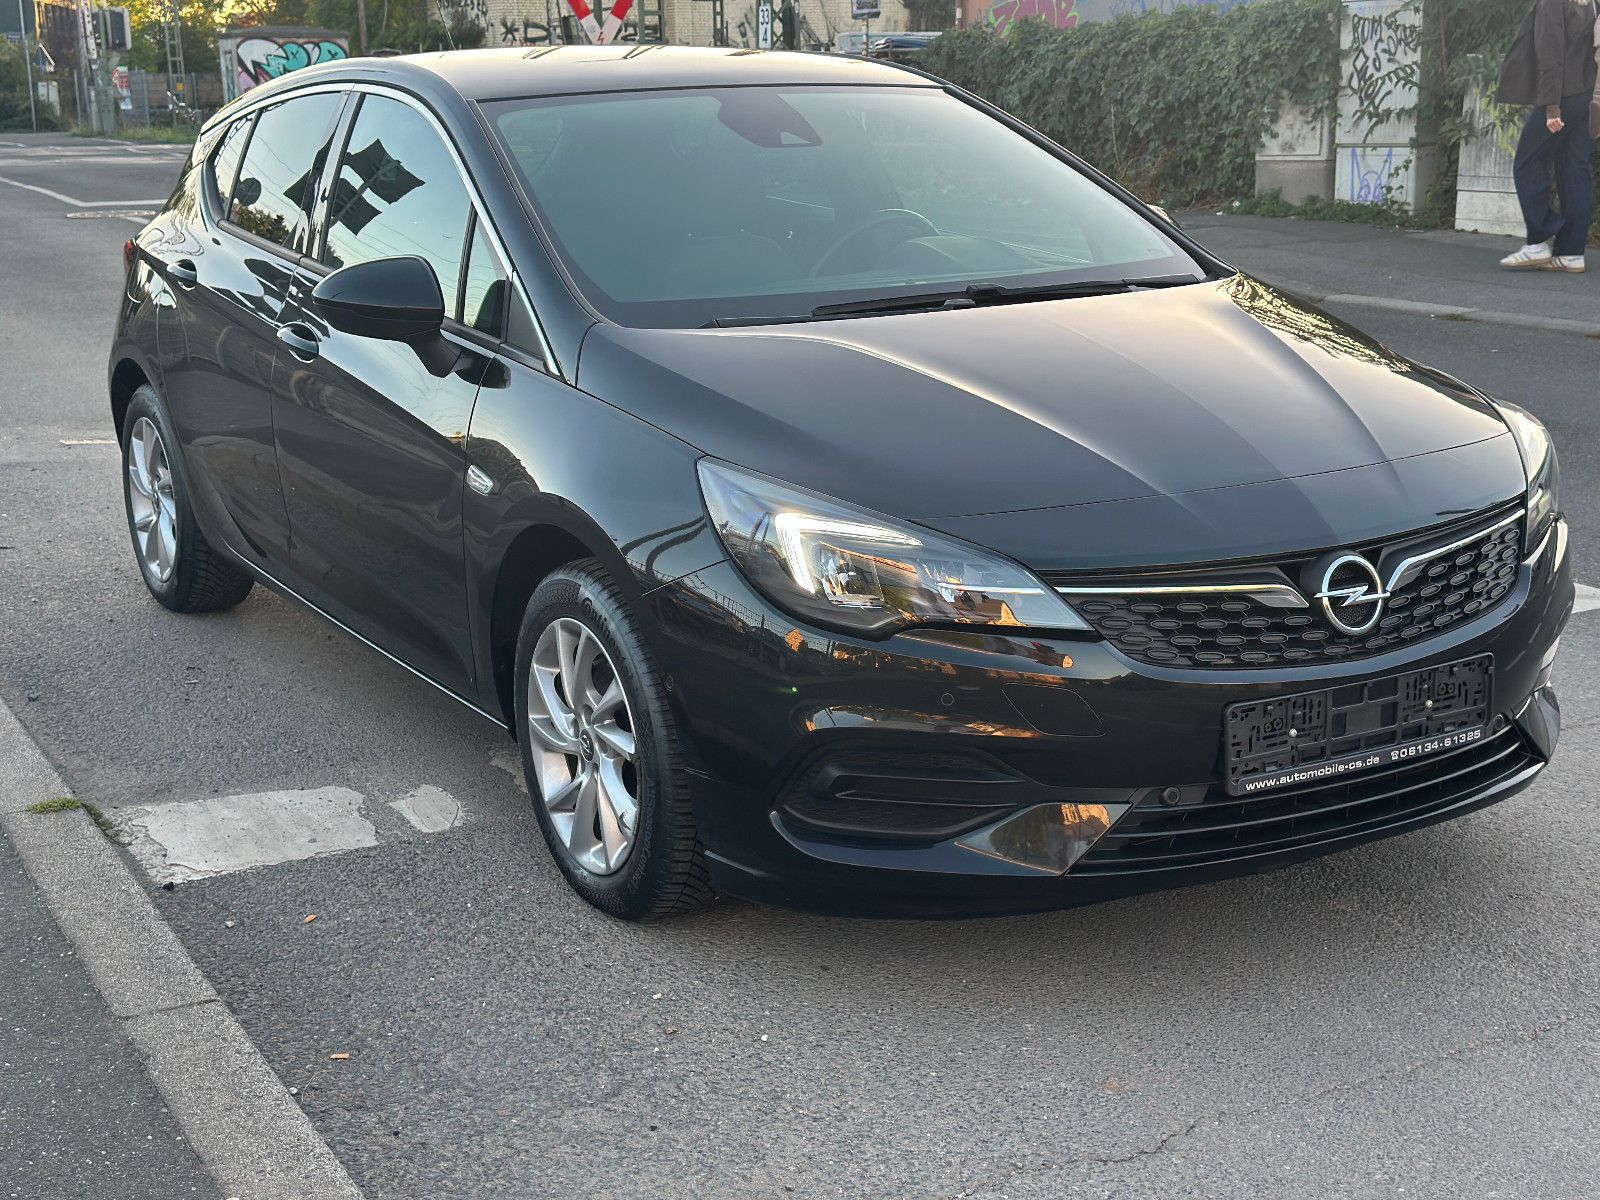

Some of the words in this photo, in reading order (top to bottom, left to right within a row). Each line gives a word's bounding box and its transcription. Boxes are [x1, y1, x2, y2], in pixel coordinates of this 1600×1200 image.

[760, 8, 770, 25] 33
[762, 27, 768, 44] 4
[1245, 755, 1380, 791] www.automobile-cs.de
